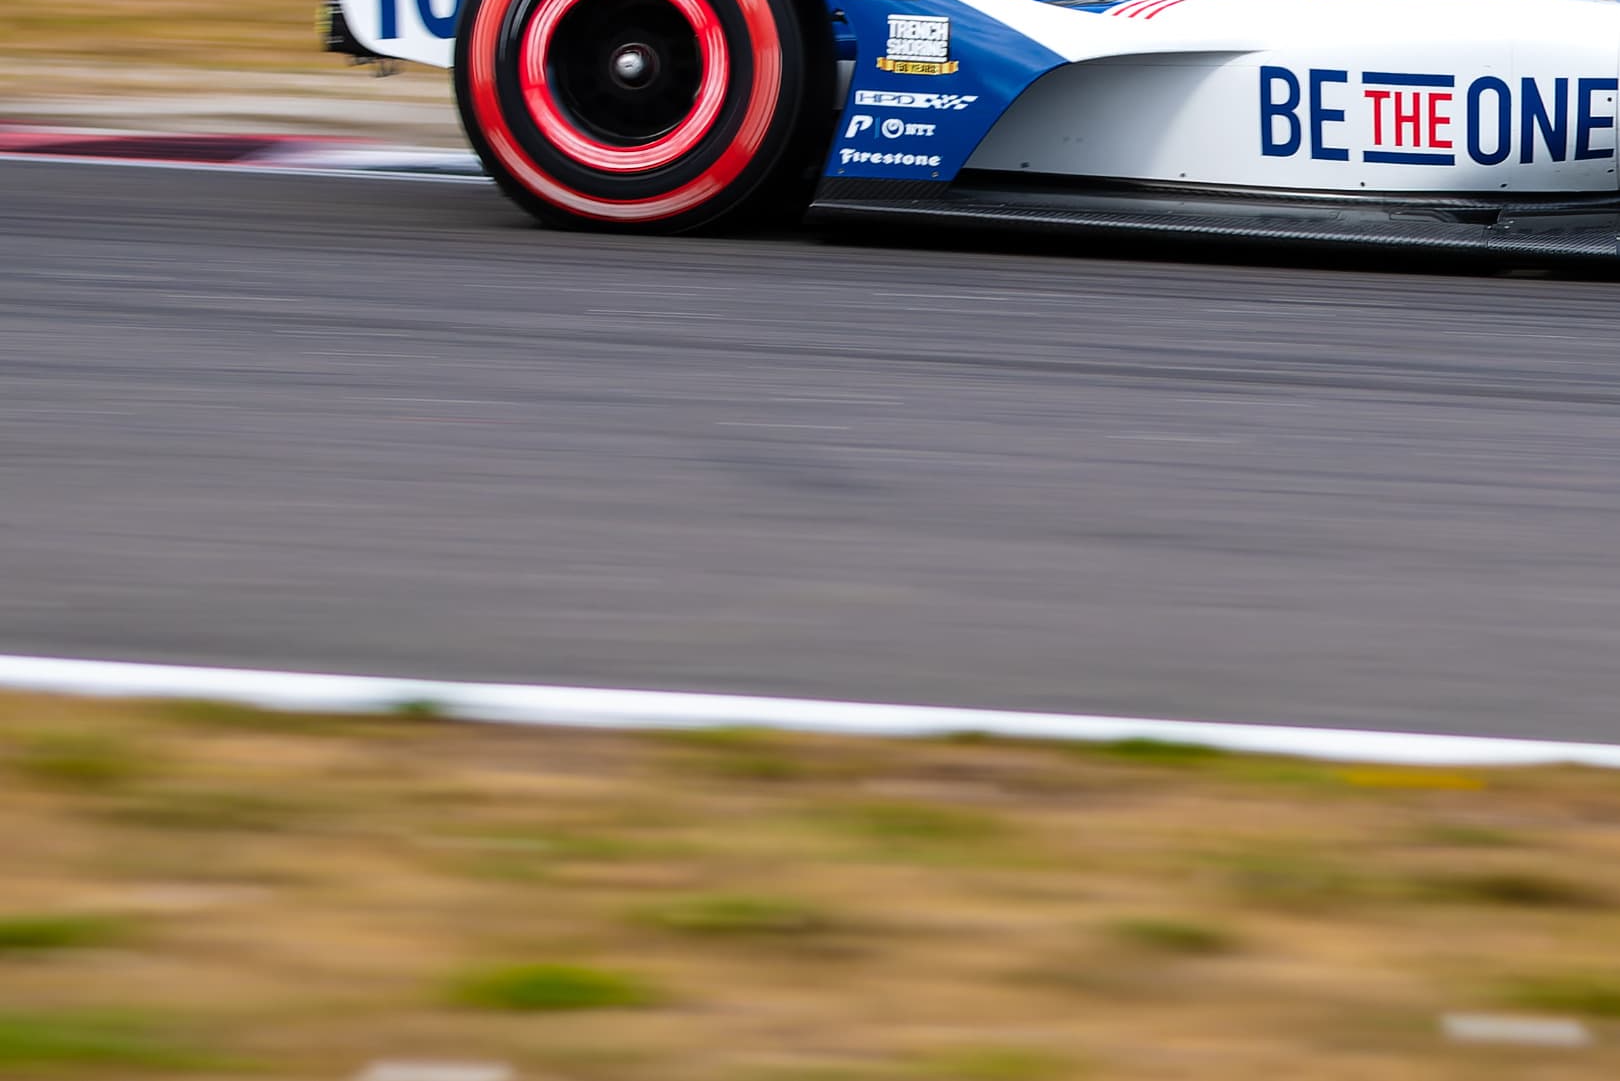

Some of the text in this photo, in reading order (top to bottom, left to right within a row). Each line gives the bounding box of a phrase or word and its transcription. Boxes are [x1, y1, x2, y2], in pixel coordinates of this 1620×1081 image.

[887, 20, 949, 41] TRENCH
[1260, 65, 1619, 166] BE THE ONE
[839, 148, 942, 167] Firestone
